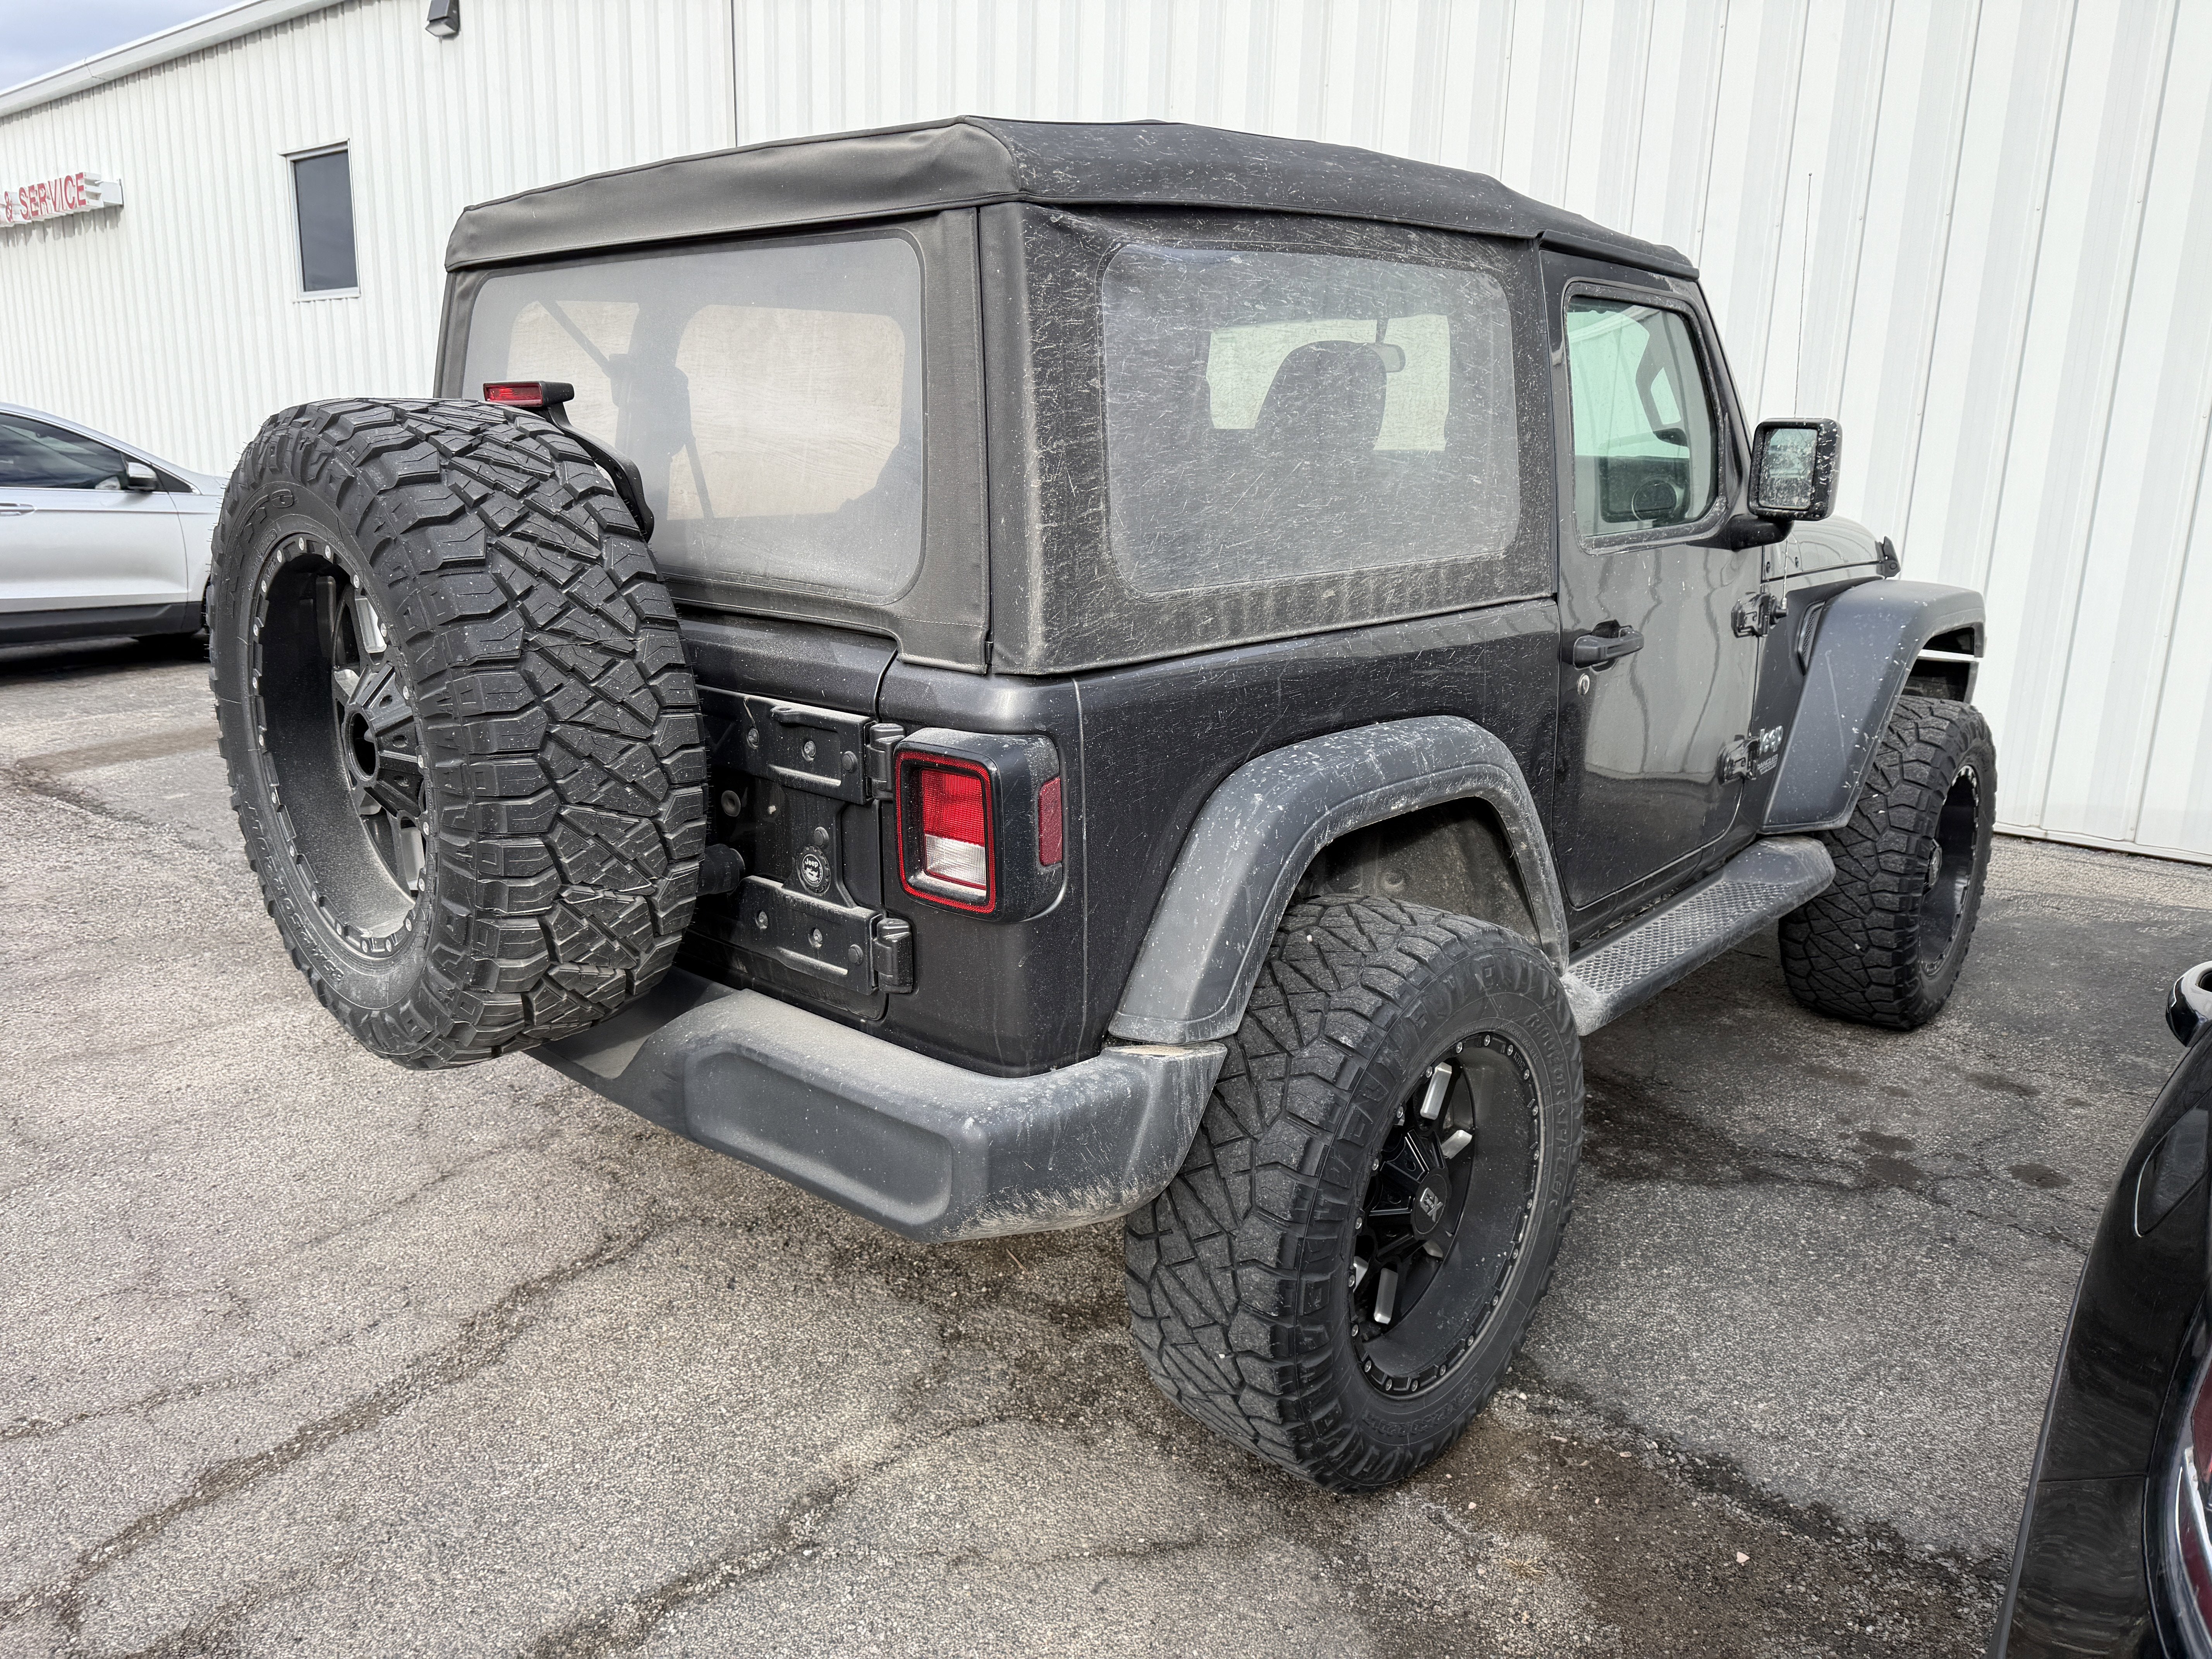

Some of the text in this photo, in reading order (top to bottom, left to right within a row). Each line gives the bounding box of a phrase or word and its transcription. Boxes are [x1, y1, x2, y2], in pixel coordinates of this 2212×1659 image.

[4, 172, 86, 222] & SERVICE
[1759, 725, 1783, 755] Jeep
[805, 858, 818, 868] Jeep
